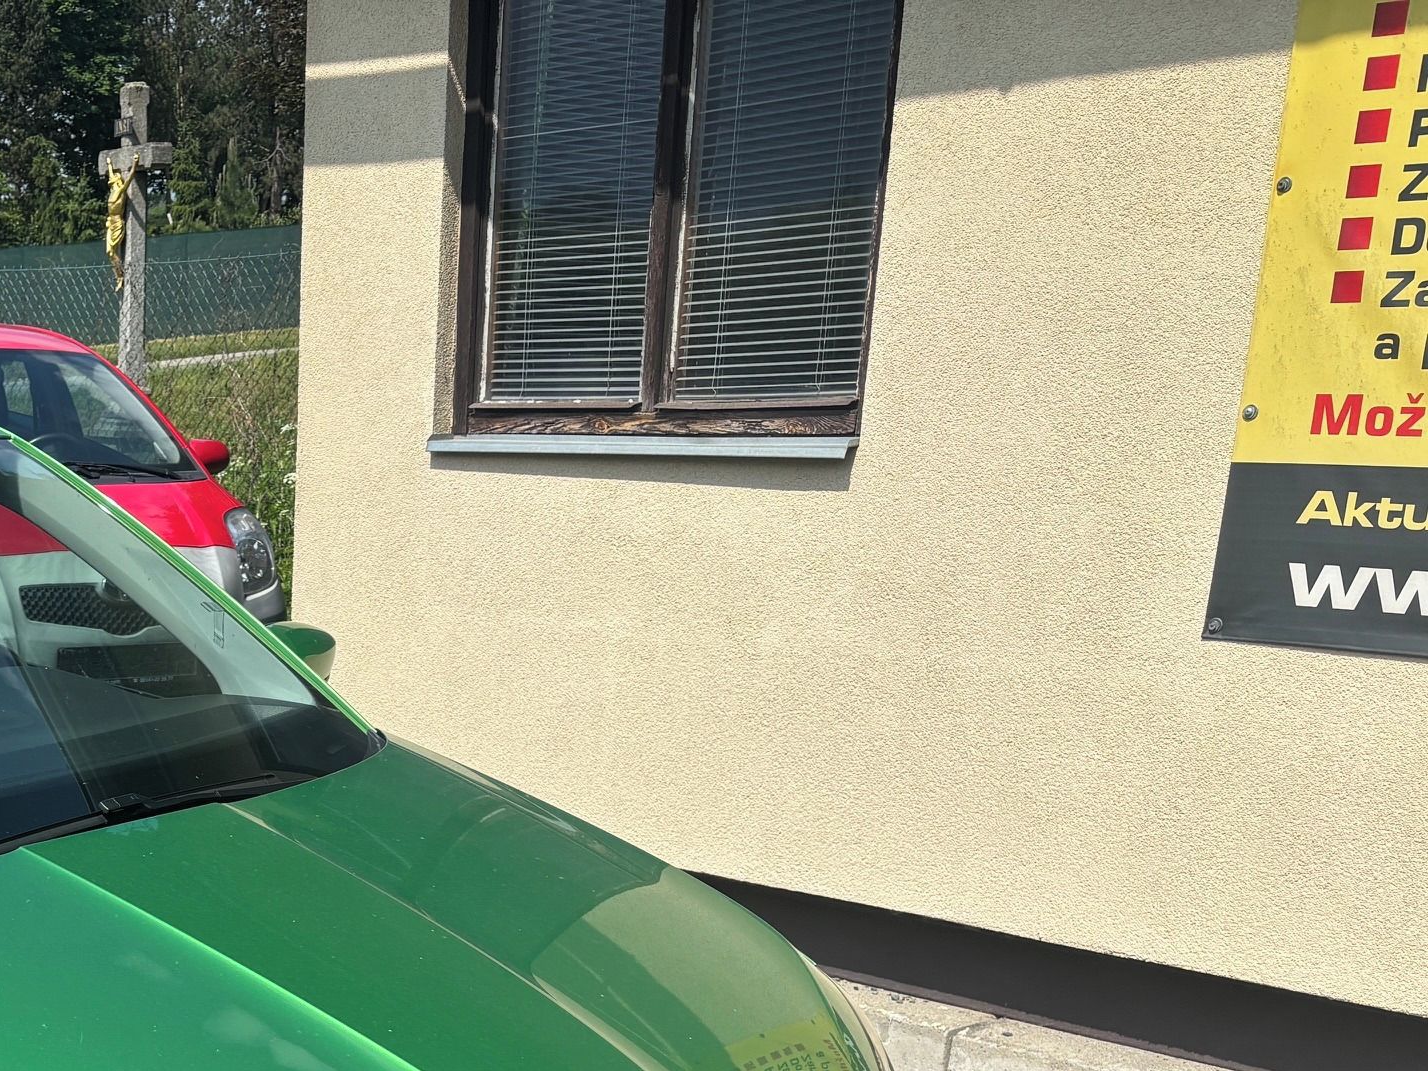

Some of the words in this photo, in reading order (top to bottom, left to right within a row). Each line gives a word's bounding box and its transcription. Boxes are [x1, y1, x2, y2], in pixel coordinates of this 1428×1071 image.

[1390, 217, 1428, 256] D
[1372, 332, 1401, 360] a
[1310, 392, 1427, 438] Mož
[1295, 490, 1428, 532] Aktu
